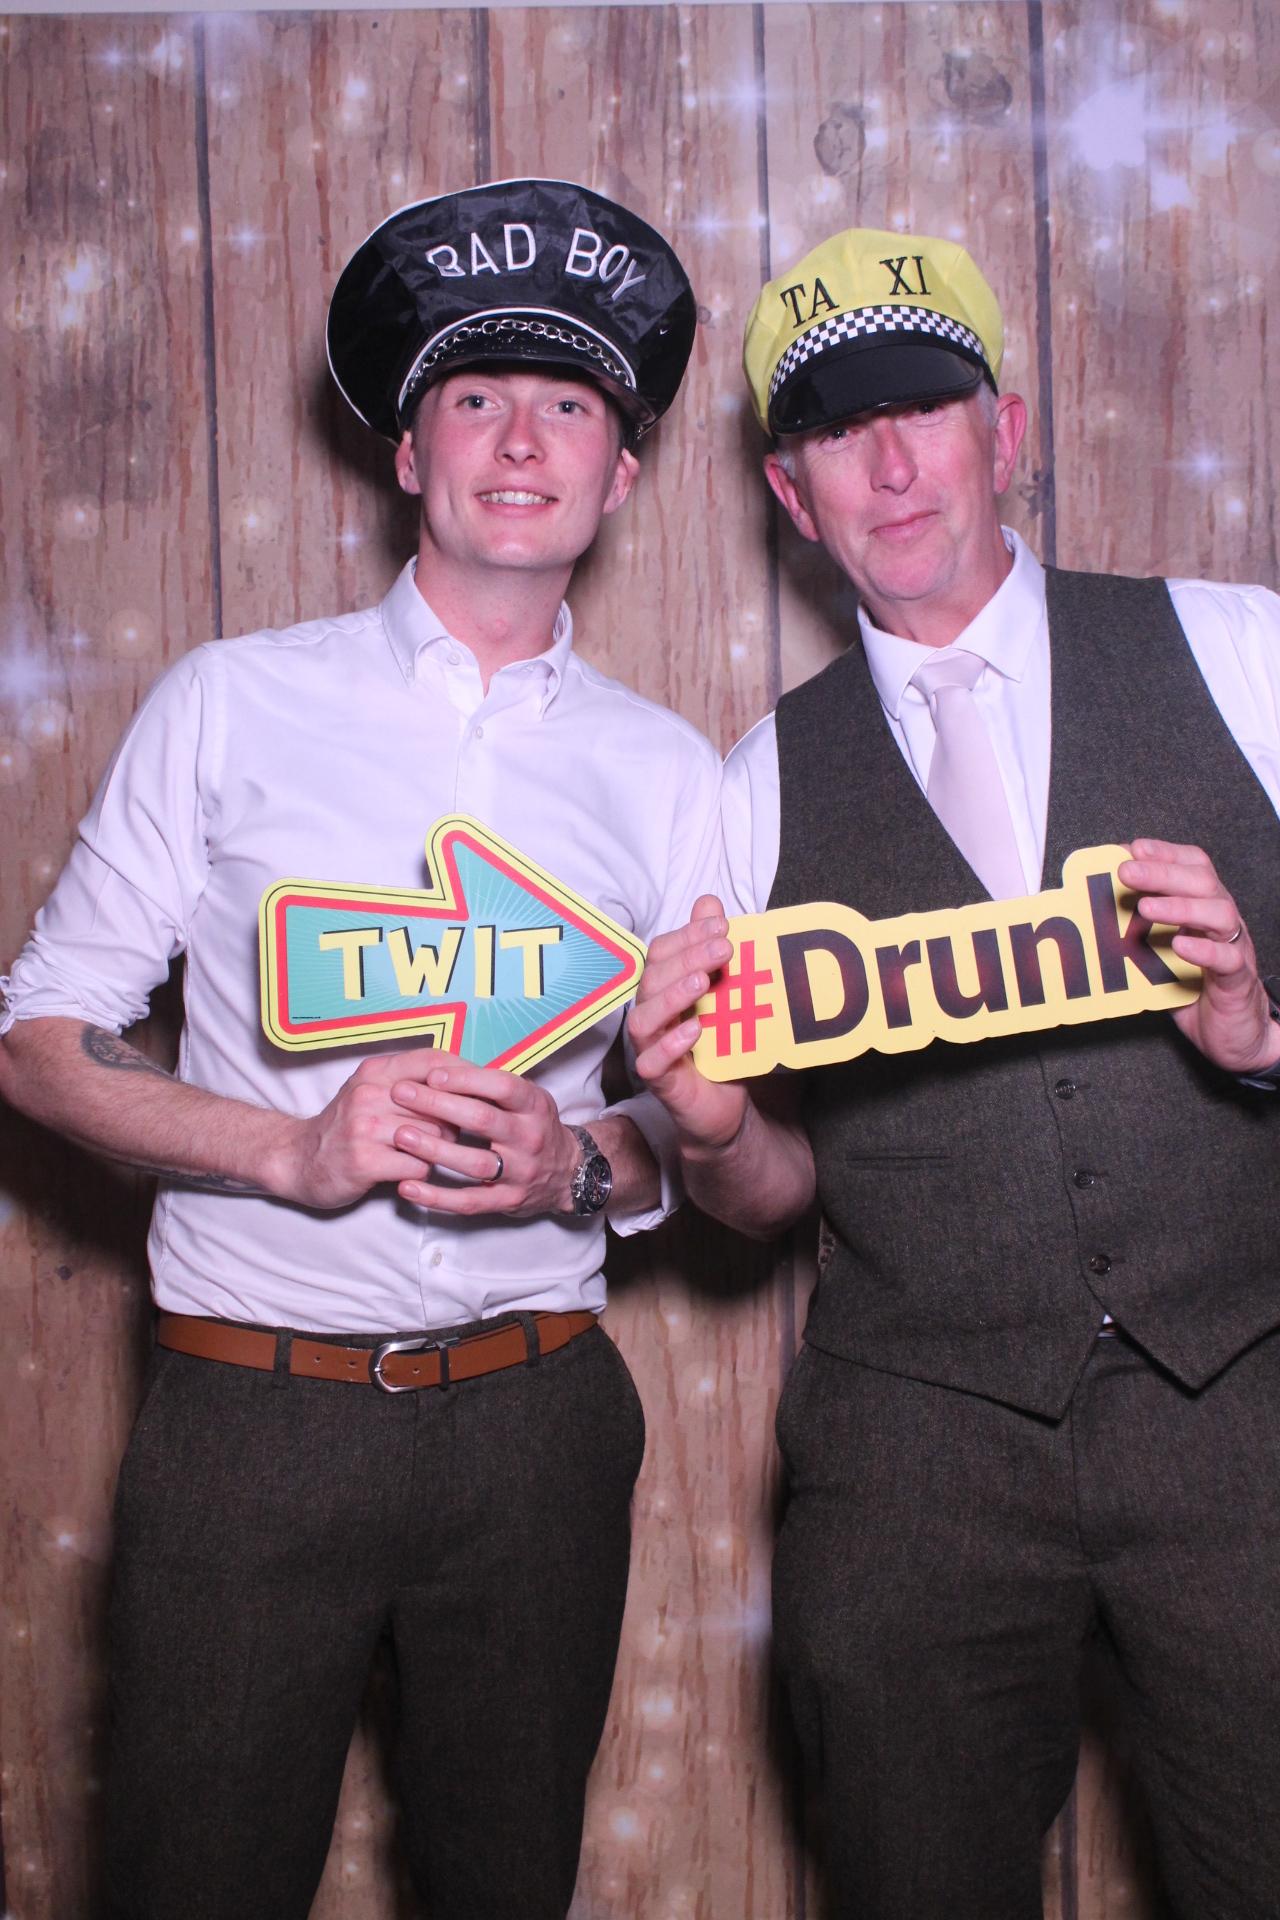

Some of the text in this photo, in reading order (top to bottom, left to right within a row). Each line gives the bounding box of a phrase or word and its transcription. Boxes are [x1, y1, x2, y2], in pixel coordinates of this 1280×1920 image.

[425, 223, 646, 300] BAD BOY
[318, 924, 564, 1000] TWIT
[699, 872, 1180, 1057] #Drunk
